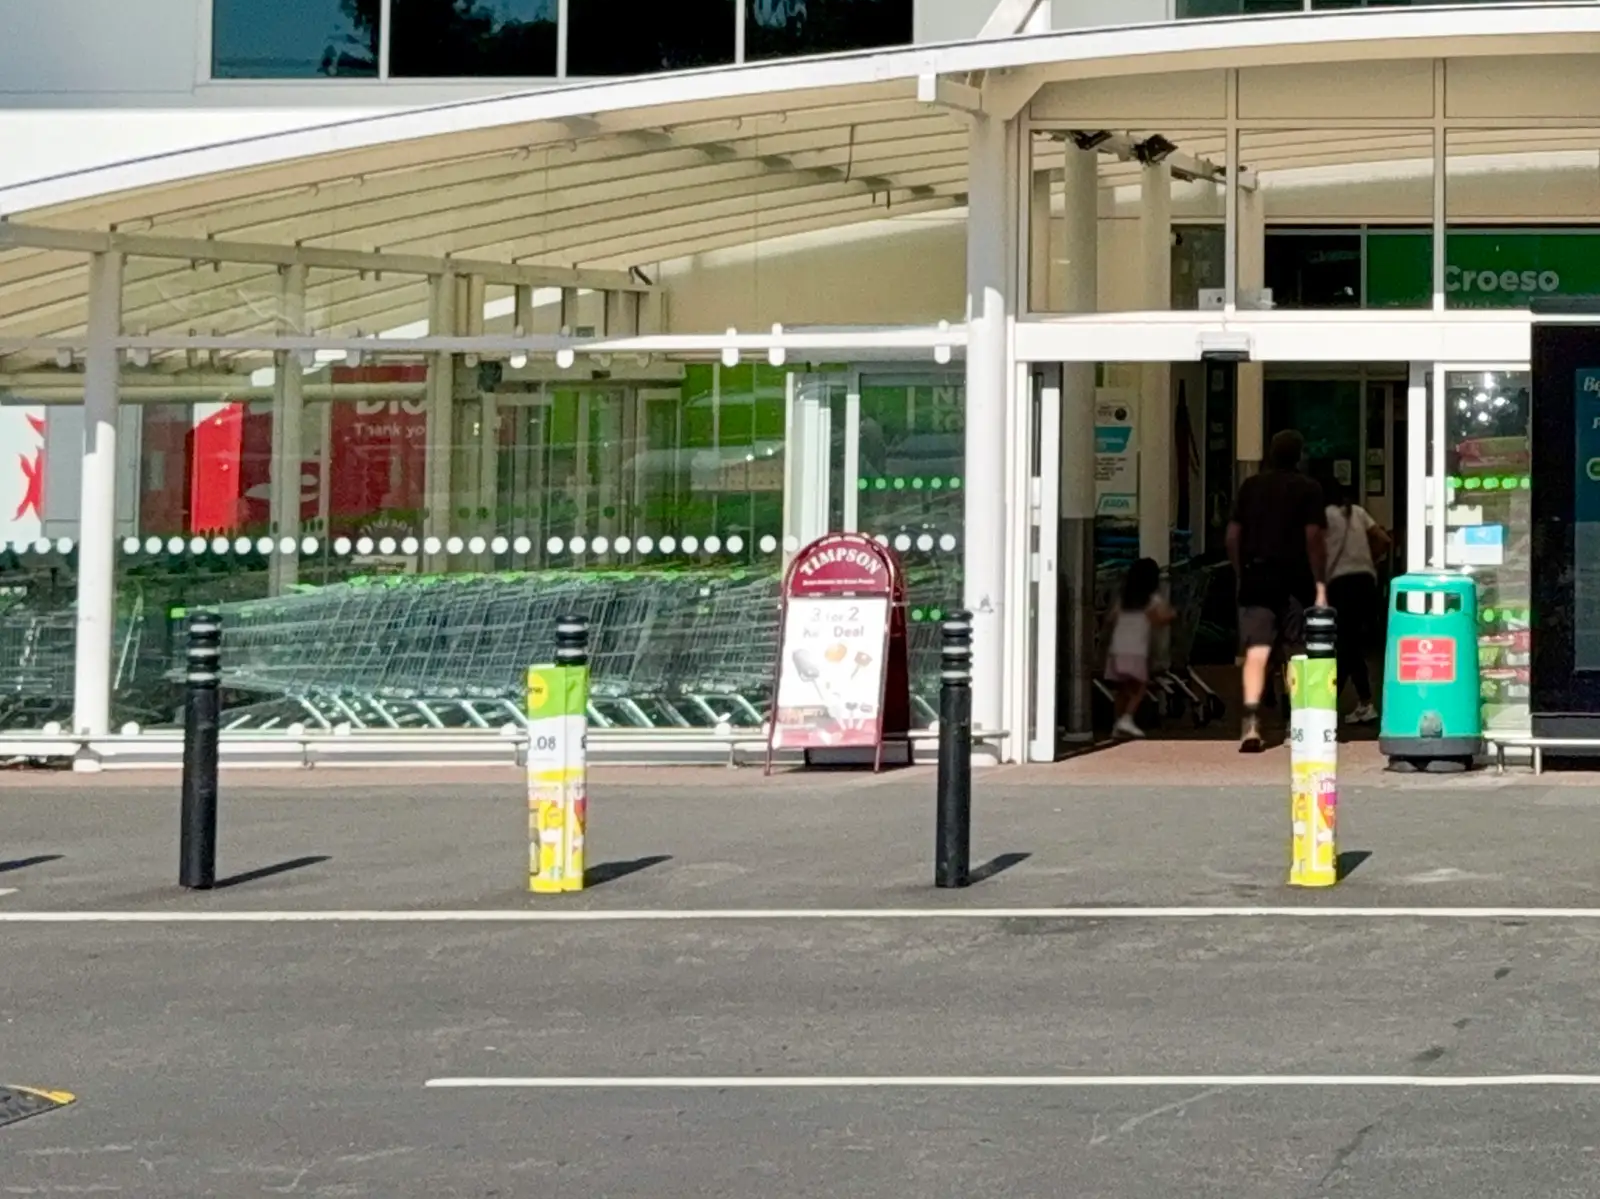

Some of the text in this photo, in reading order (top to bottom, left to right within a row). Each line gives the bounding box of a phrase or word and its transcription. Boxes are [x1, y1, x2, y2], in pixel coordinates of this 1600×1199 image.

[1445, 264, 1560, 292] Croeso
[352, 422, 426, 438] Thank yo
[799, 547, 882, 577] TIMPSON
[848, 606, 860, 621] 2
[833, 625, 865, 638] Deal
[528, 735, 557, 751] .08
